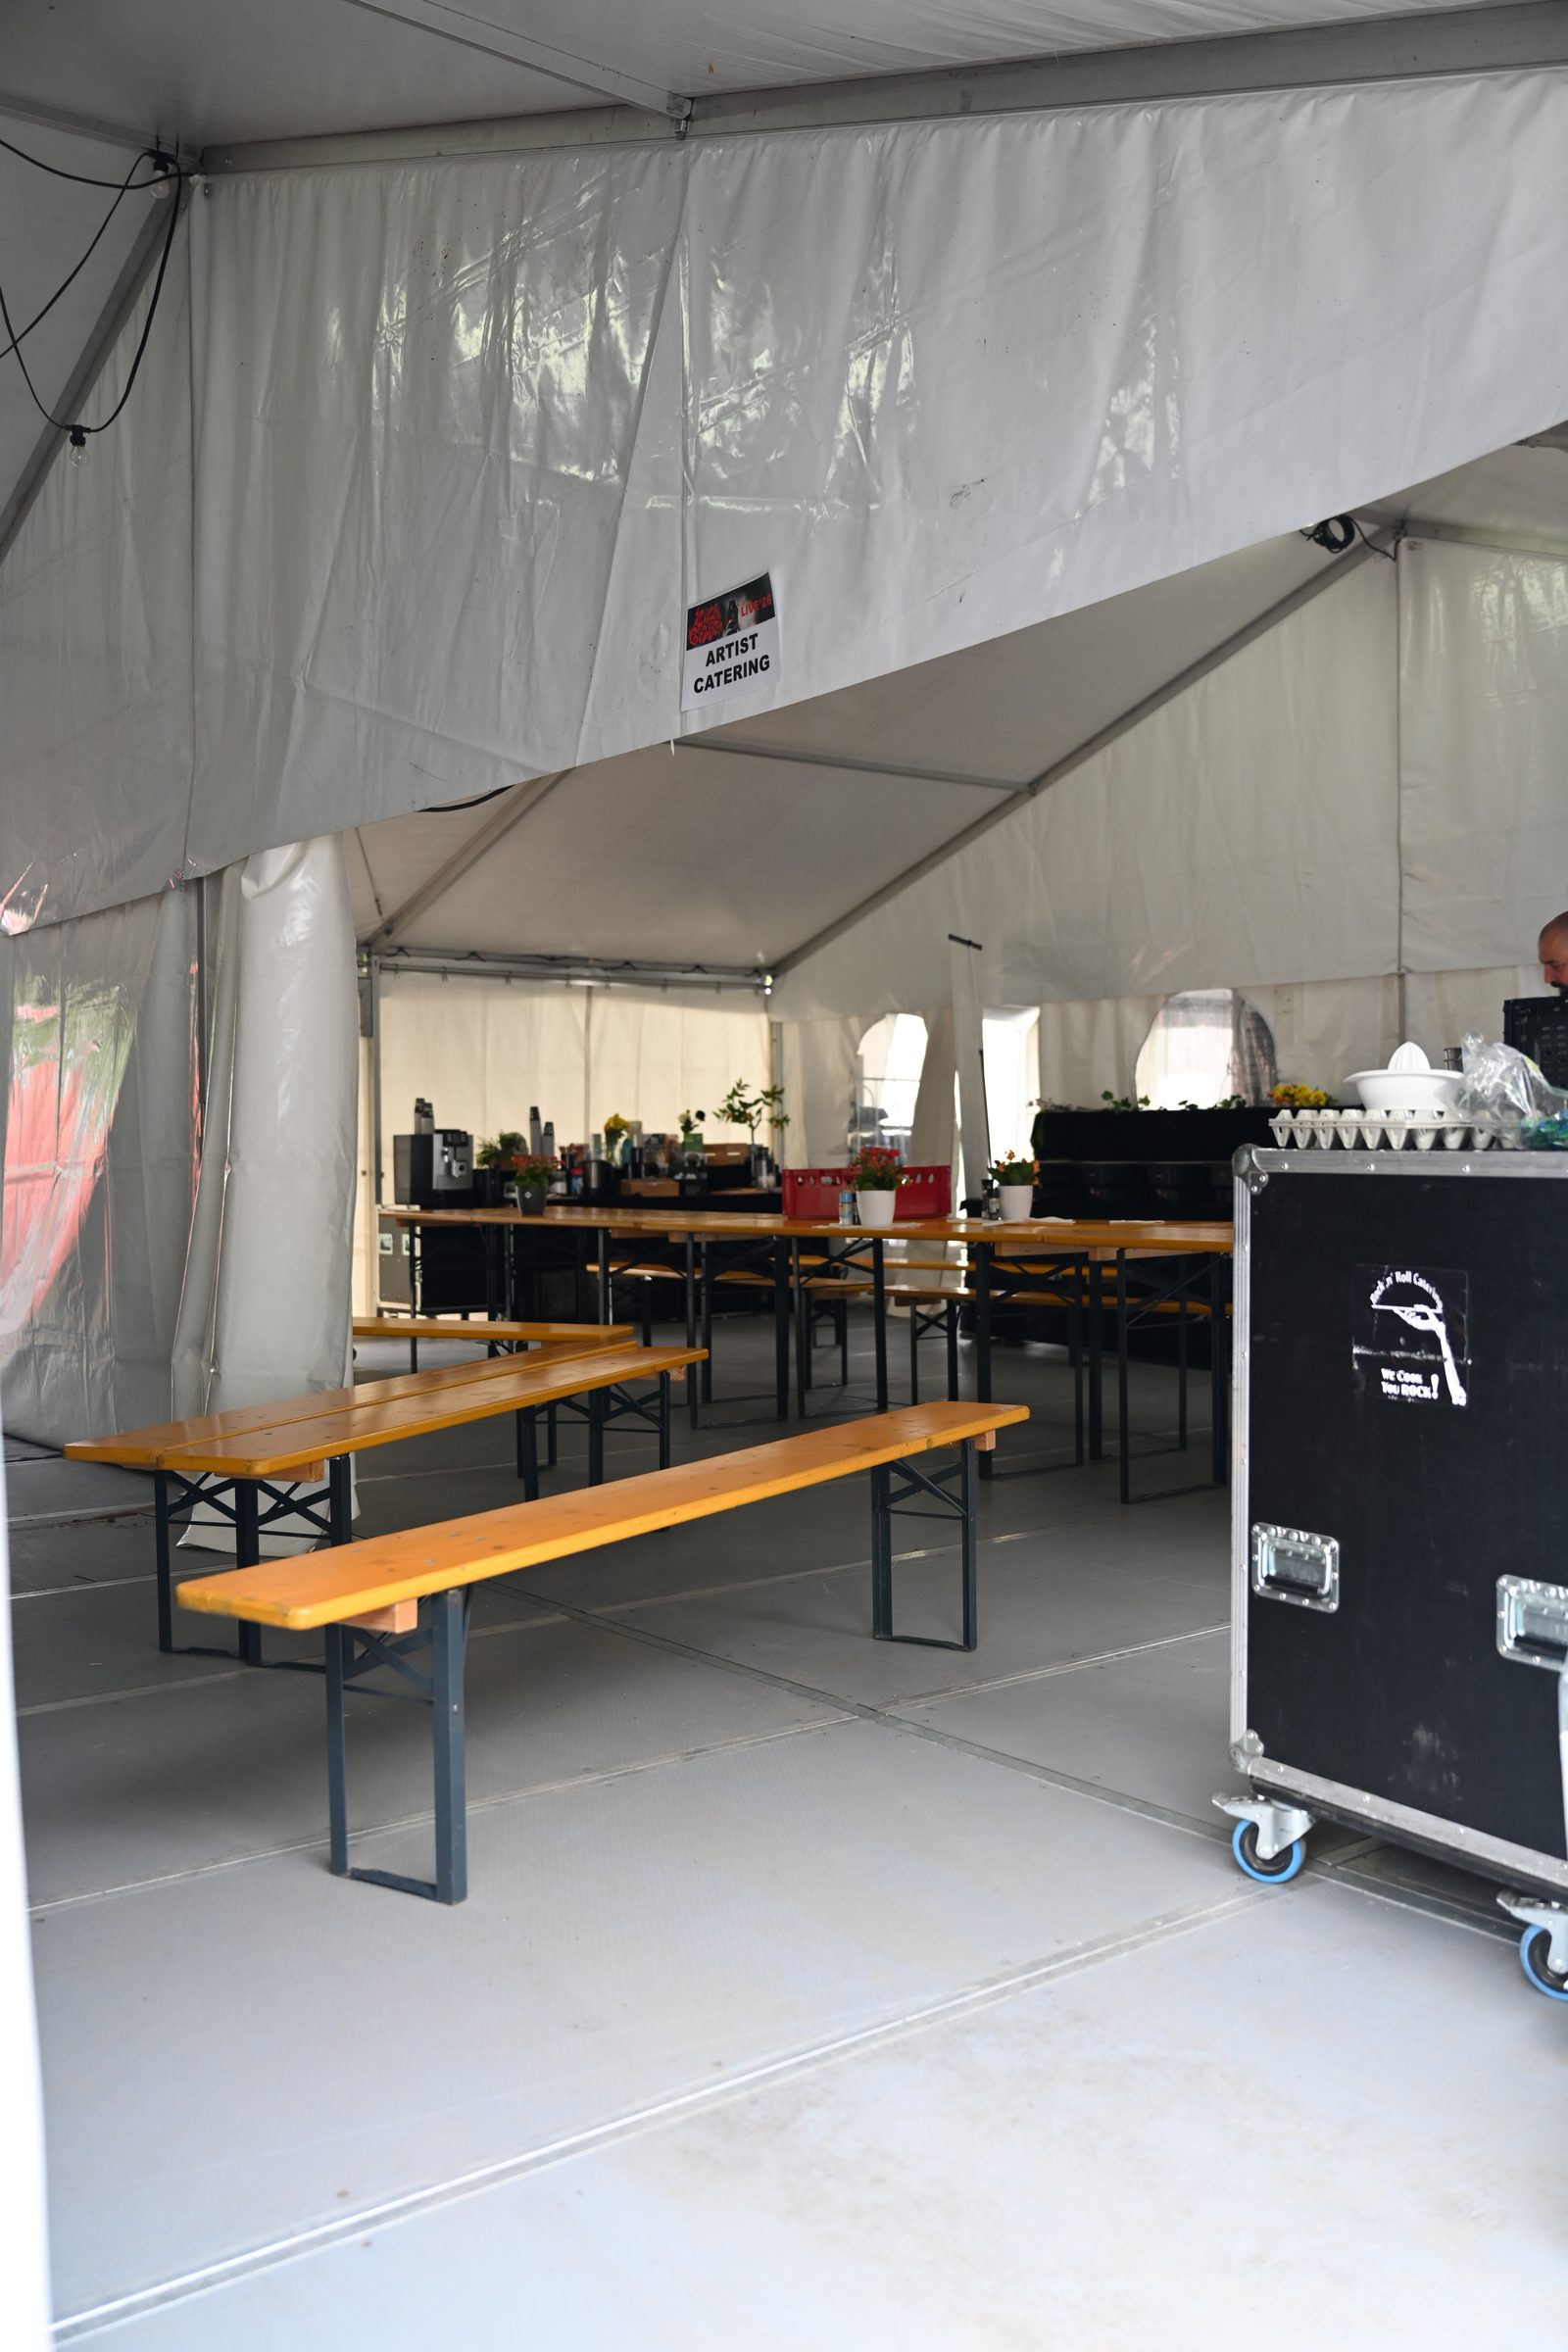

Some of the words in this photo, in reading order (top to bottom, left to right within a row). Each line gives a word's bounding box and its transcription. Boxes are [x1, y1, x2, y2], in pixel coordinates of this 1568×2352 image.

[741, 602, 760, 616] LIVE
[705, 632, 759, 667] ARTIST
[693, 654, 770, 694] CATERING
